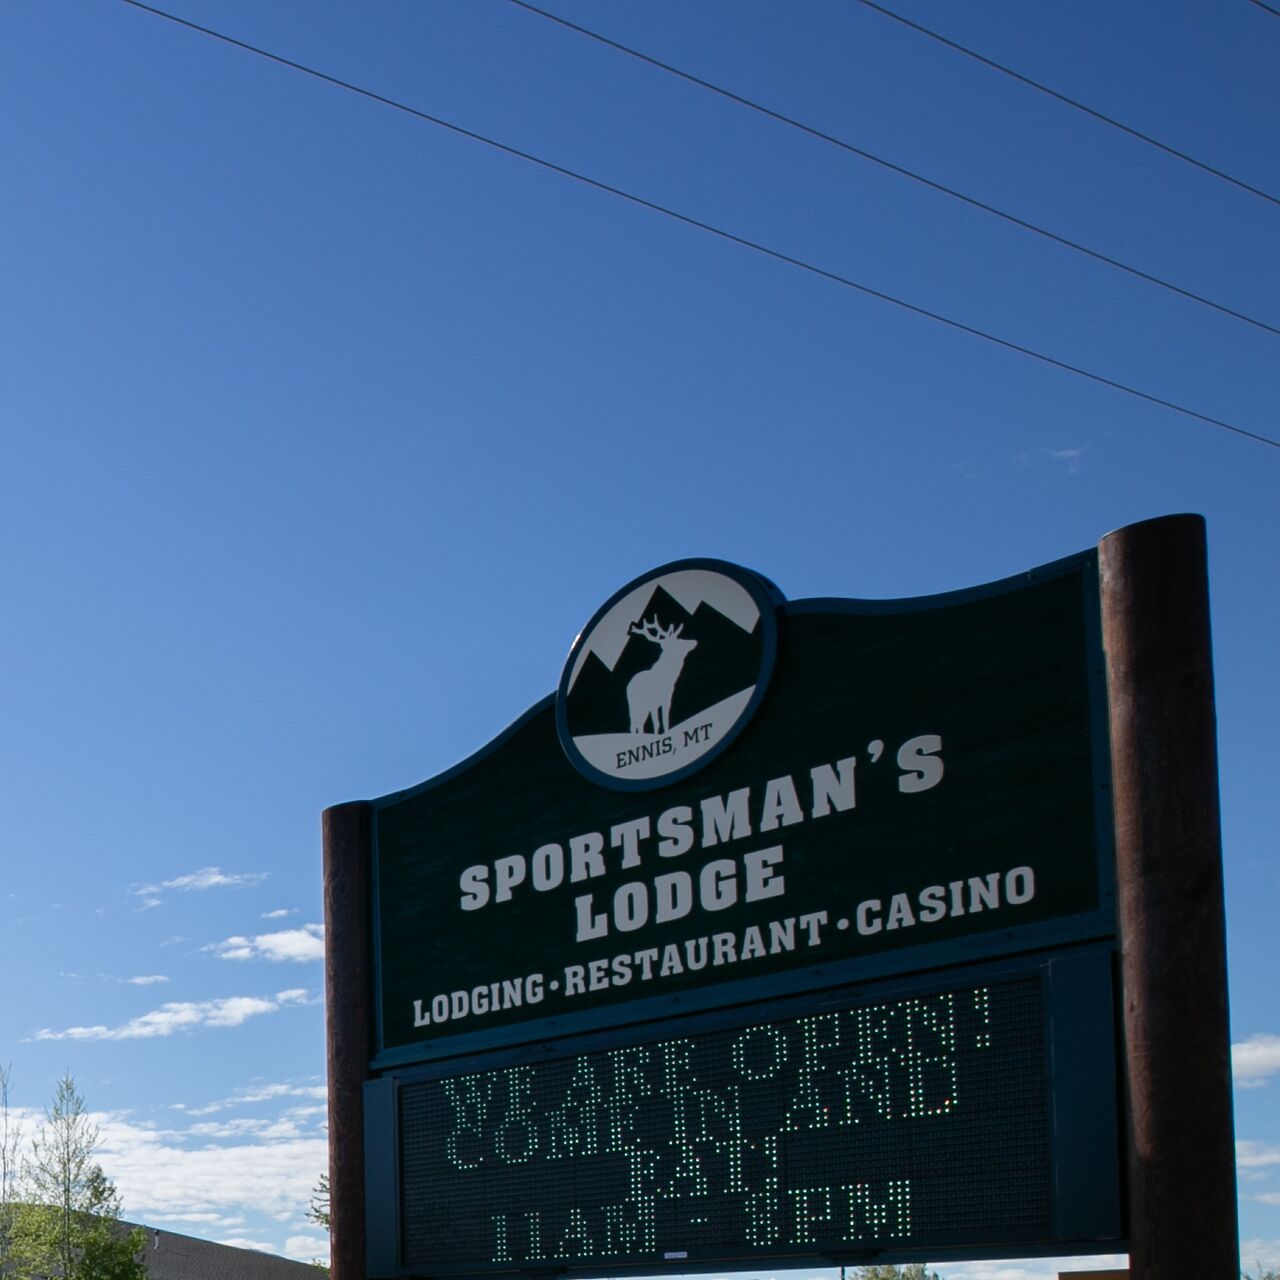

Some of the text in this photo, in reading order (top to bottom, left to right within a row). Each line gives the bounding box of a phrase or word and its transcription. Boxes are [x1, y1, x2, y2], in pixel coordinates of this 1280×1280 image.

[615, 722, 713, 769] ENNIS, MT
[459, 734, 944, 912] SPORTSMAN'S
[413, 865, 1036, 1028] LODGING RESTAURANT CASINO
[574, 844, 786, 943] LODGE
[440, 986, 991, 1138] WE ARE OPEN!
[446, 1053, 959, 1171] COME IN AND
[491, 1199, 657, 1263] 11AM
[745, 1180, 913, 1247] 8PM
